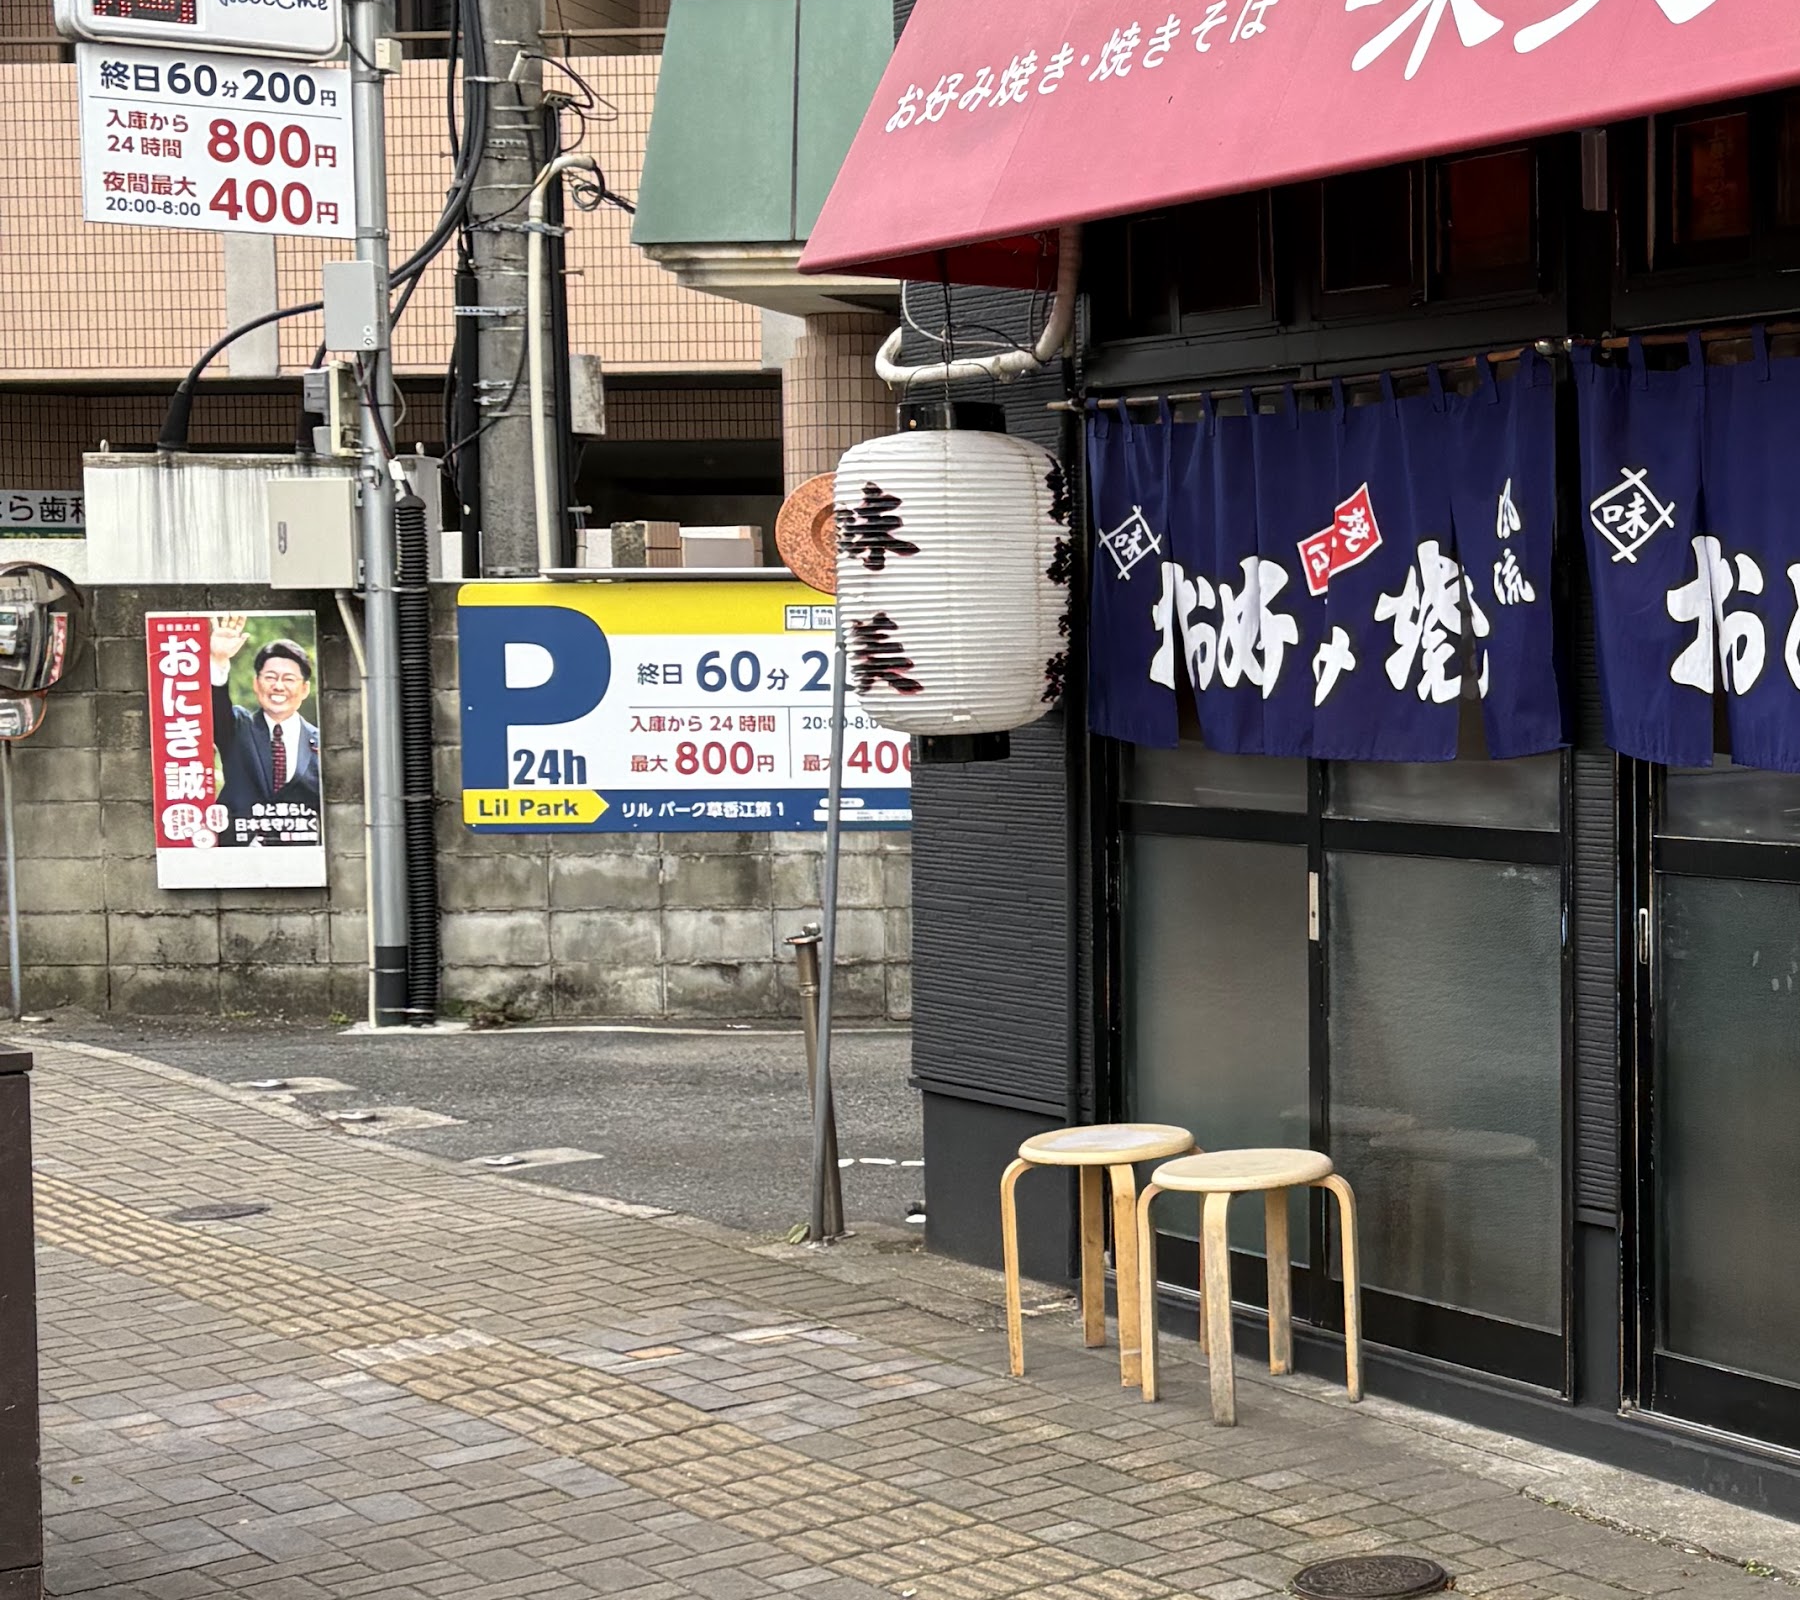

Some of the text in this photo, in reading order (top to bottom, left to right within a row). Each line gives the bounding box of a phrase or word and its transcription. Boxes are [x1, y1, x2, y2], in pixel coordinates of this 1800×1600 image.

[107, 108, 189, 133] 入庫から
[207, 118, 337, 168] 800円
[103, 172, 197, 197] 夜間最大
[106, 197, 201, 217] 20:00-8:00
[208, 178, 339, 226] 400円
[0, 495, 84, 523] ら歯科
[457, 606, 611, 789] P
[158, 634, 206, 801] おにき誠
[513, 748, 587, 785] 24h
[479, 799, 579, 817] Lil Park
